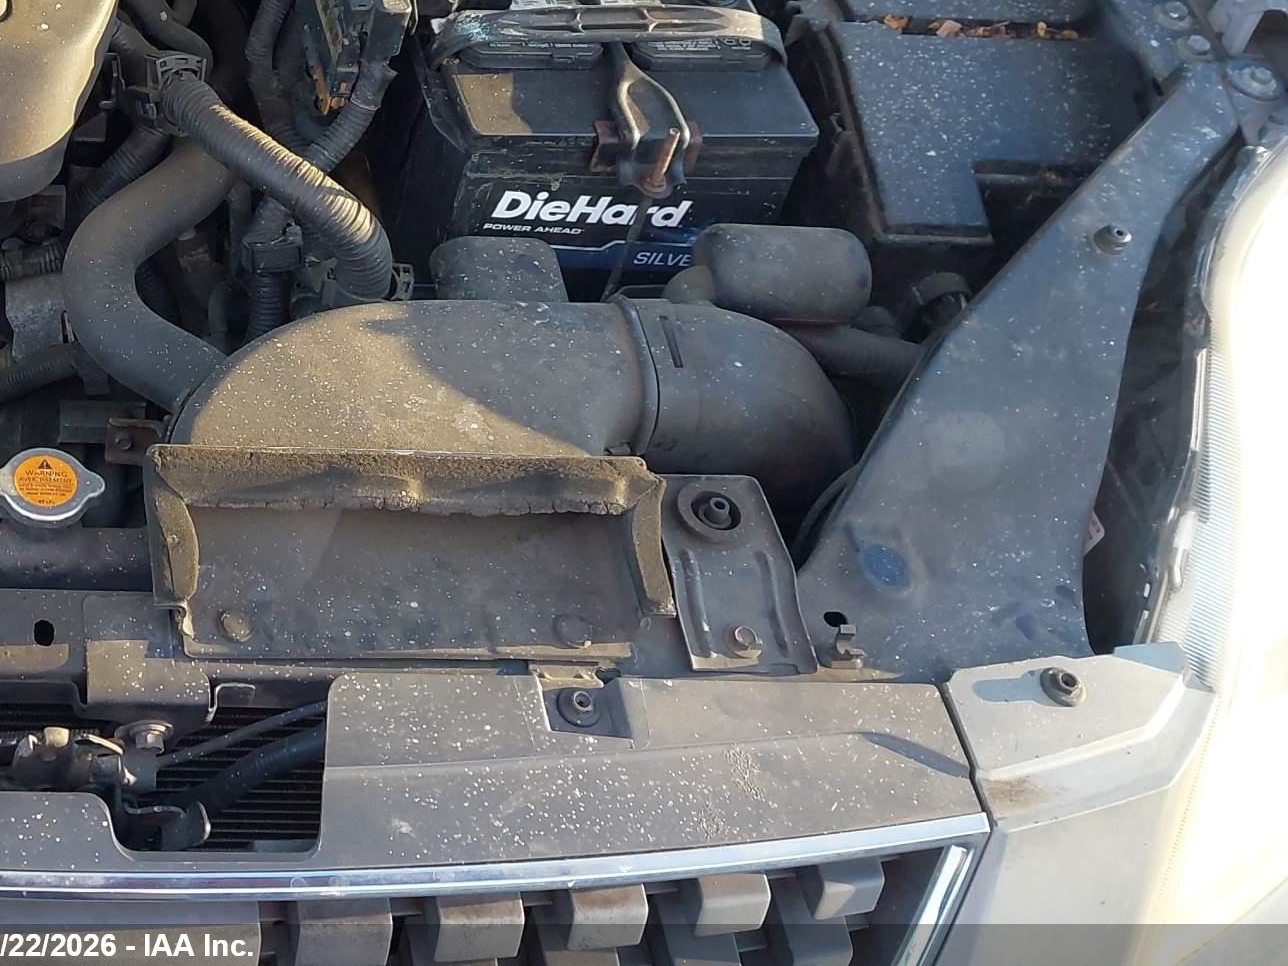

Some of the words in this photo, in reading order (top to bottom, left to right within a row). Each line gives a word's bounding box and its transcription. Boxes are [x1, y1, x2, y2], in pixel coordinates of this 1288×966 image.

[482, 223, 531, 232] POWER
[534, 226, 582, 235] AHEAD
[633, 252, 692, 267] SILVE
[25, 470, 68, 478] WARNING
